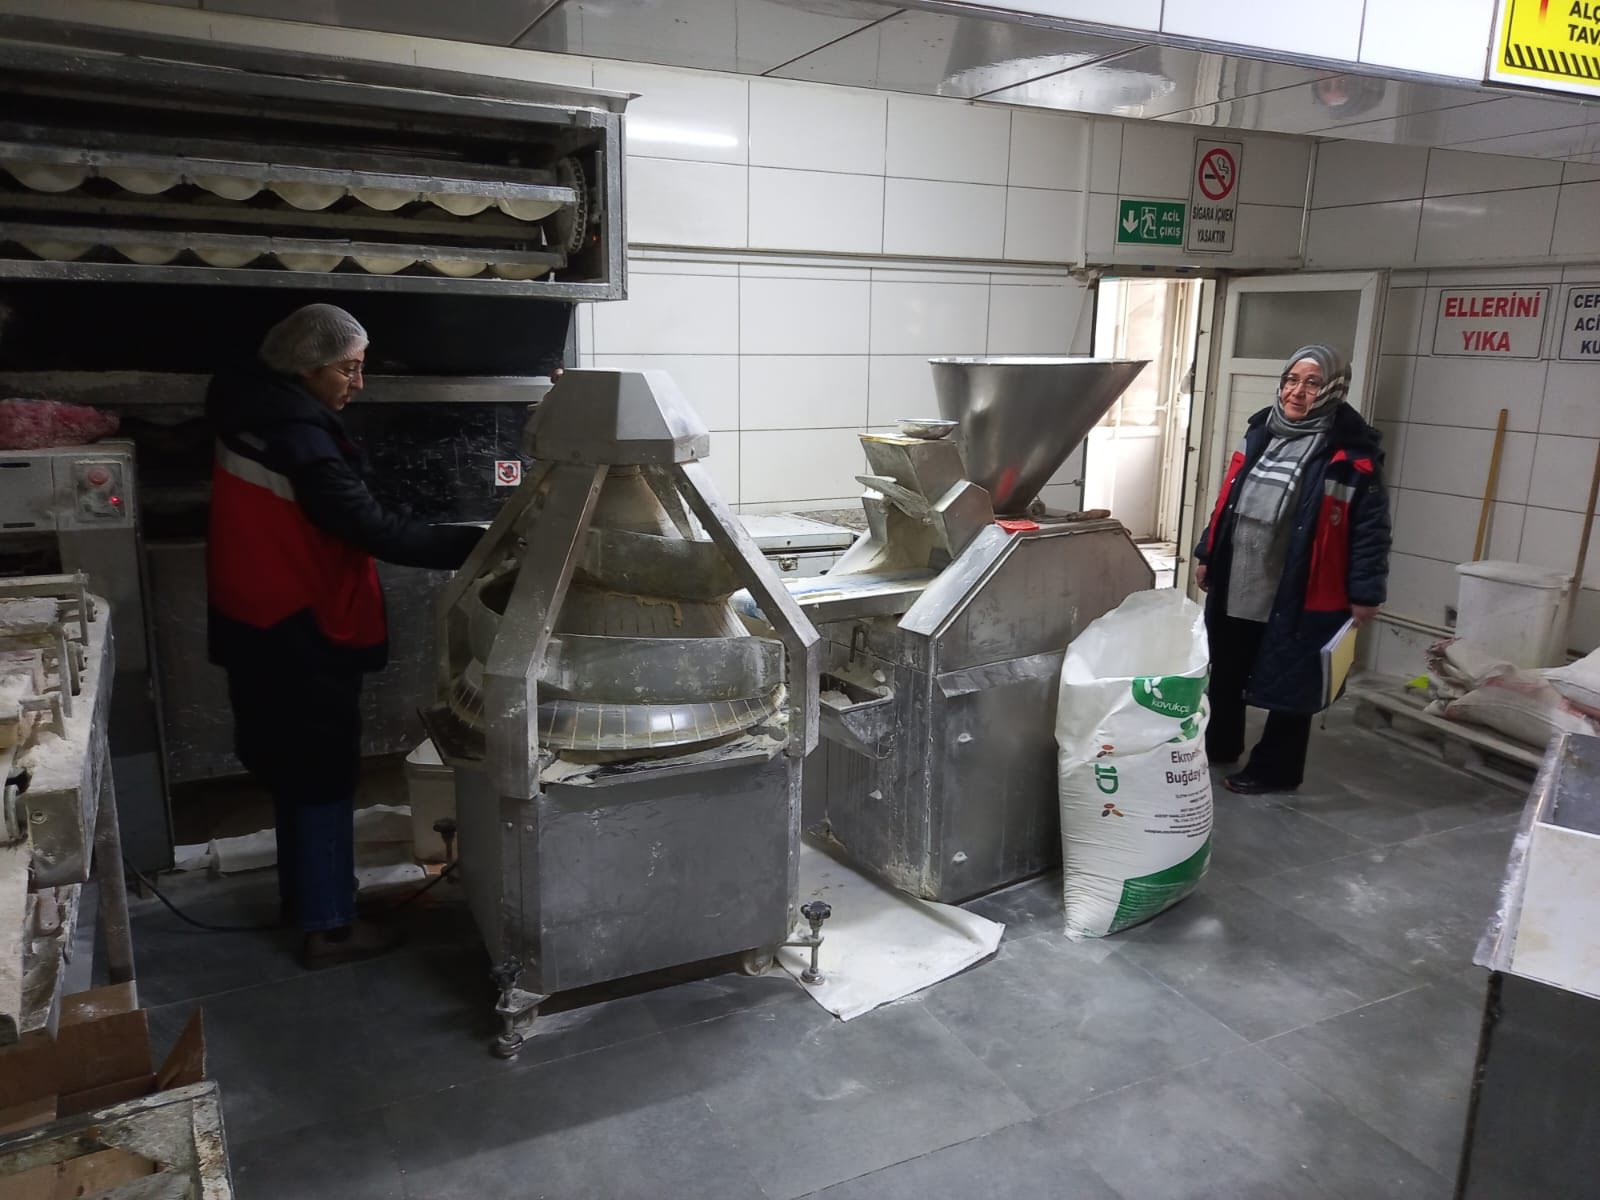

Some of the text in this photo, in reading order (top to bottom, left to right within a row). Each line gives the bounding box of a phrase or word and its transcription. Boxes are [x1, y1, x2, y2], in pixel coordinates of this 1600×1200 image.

[1568, 24, 1600, 46] TAV
[1162, 209, 1180, 222] ACİL
[1159, 226, 1181, 239] ÇIKIŞ
[1197, 230, 1225, 243] YASAKTIR
[1444, 292, 1541, 318] ELLERİNİ
[1462, 331, 1511, 351] YIKA
